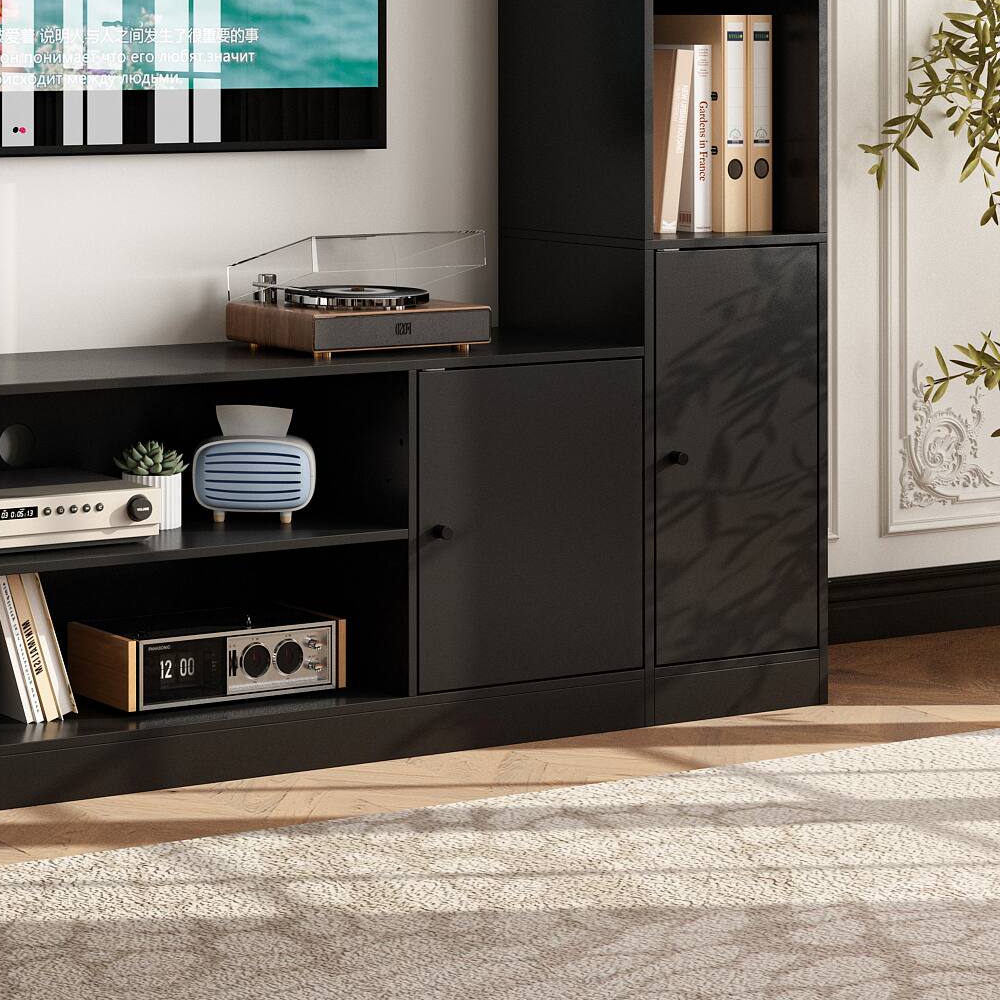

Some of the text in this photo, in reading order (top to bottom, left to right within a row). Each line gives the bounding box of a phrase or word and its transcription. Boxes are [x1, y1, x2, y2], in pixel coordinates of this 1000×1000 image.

[131, 52, 154, 64] его
[698, 101, 709, 182] Gardens in France
[159, 659, 173, 680] 12
[179, 657, 195, 677] 00
